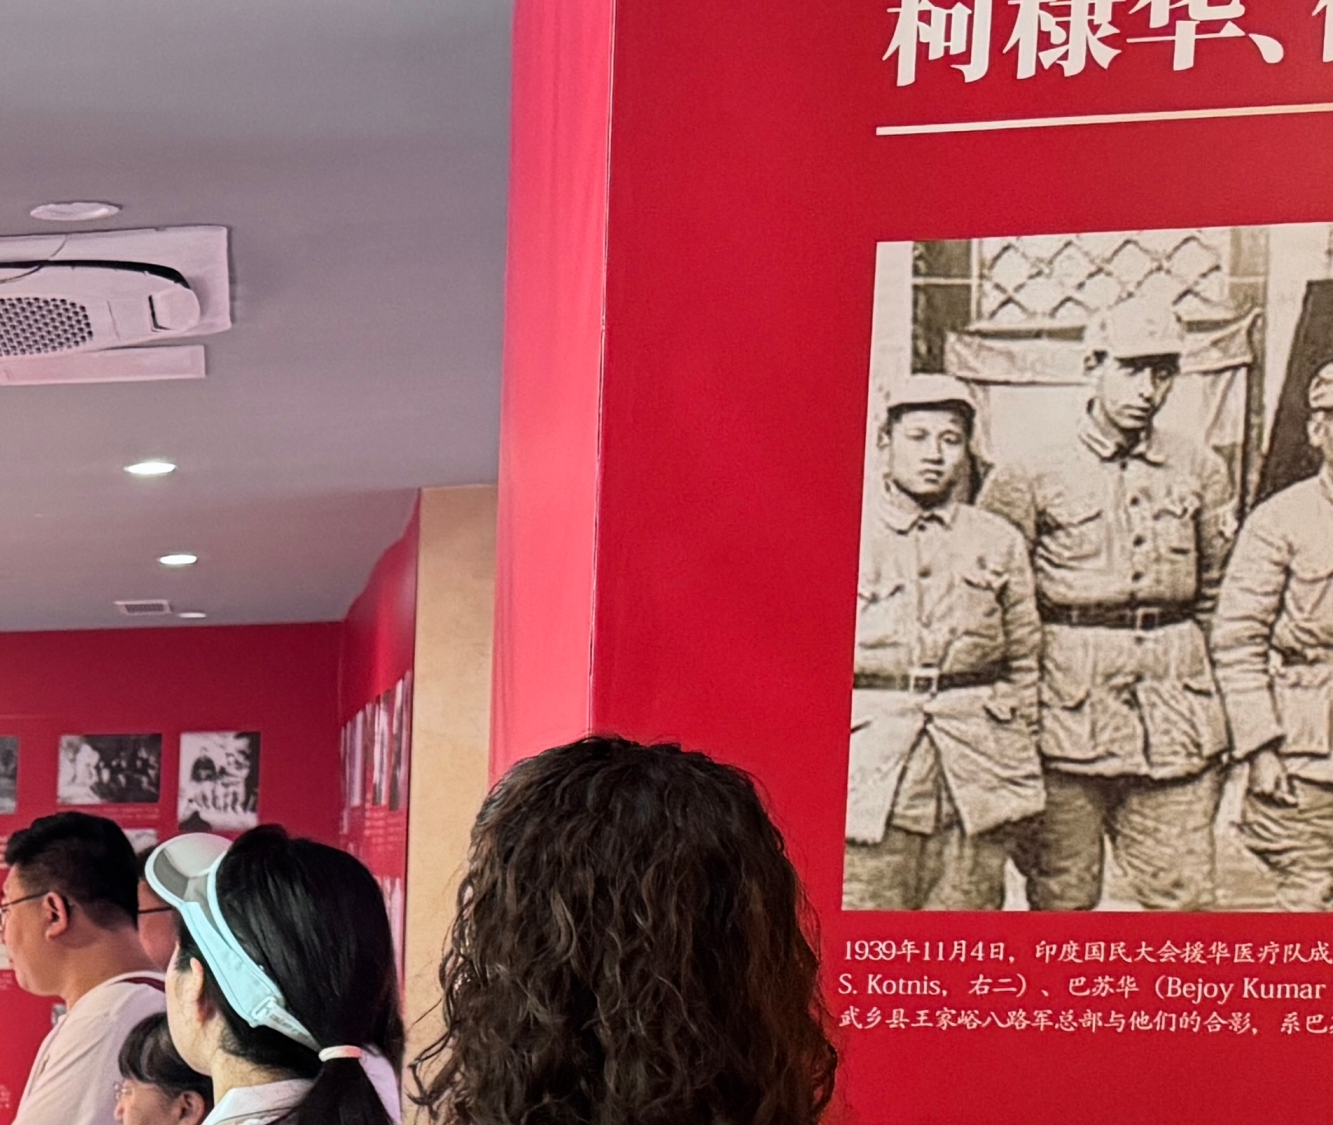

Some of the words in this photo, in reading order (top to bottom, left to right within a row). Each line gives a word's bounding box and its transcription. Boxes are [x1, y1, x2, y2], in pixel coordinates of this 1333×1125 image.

[882, 0, 1333, 86] 柯棣华、
[838, 975, 857, 996] S.
[1242, 976, 1326, 1000] Kumar
[838, 1006, 1333, 1036] 武乡县王家峪八路军总部与他们的合影，系巴
